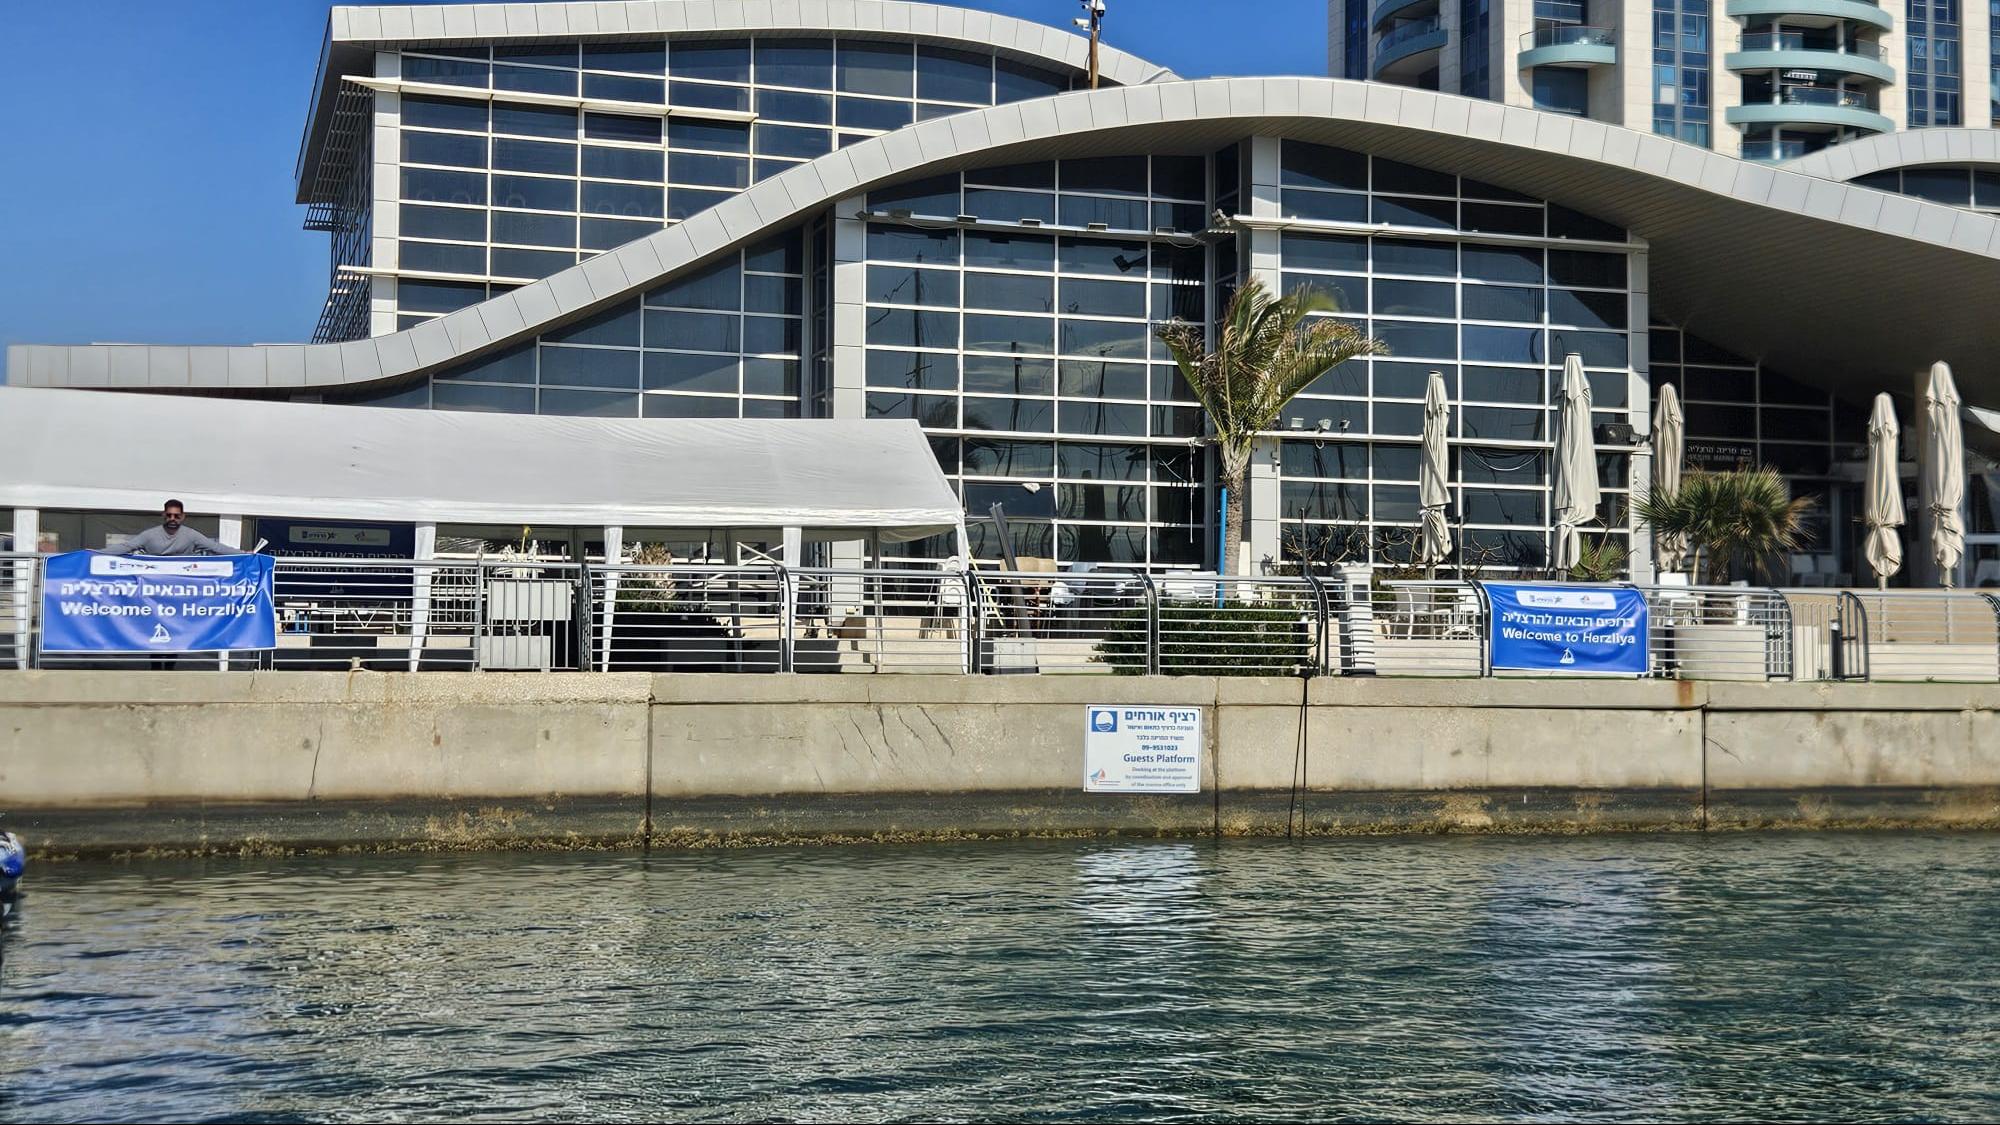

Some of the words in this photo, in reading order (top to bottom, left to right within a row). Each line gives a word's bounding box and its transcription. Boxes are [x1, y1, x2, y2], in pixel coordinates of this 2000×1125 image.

[60, 580, 139, 597] להרצליה
[142, 583, 198, 597] הבאים
[202, 583, 257, 598] ברוכים
[60, 601, 153, 617] Welcome
[157, 602, 177, 617] to
[182, 602, 257, 618] Herzliya
[1502, 611, 1552, 624] להרצליה
[1555, 616, 1593, 627] הבאים
[1596, 617, 1636, 628] ברוכים
[1502, 627, 1562, 642] Welcome
[1565, 632, 1579, 643] to
[1582, 631, 1636, 646] Herzliya
[1124, 711, 1166, 721] אורחים
[1169, 712, 1196, 724] רציף
[1123, 753, 1154, 763] Guests
[1156, 754, 1195, 763] Platform
